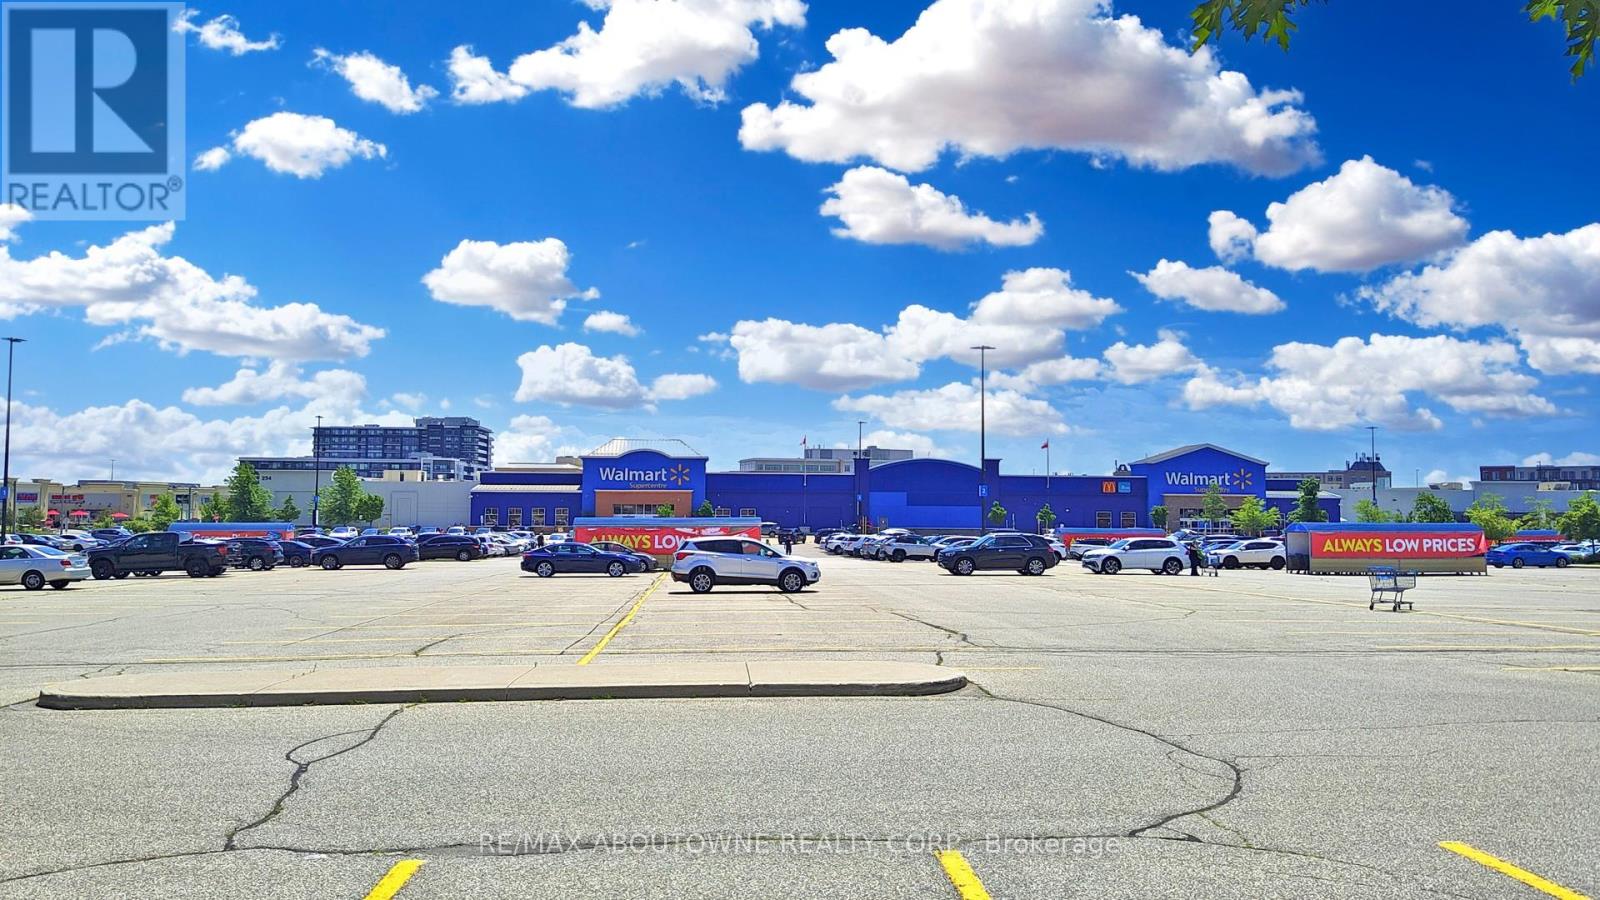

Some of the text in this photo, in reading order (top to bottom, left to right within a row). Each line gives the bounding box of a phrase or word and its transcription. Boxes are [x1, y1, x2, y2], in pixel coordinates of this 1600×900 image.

[600, 467, 667, 482] Walmart
[1166, 471, 1230, 486] Walmart
[1323, 538, 1476, 552] ALWAYS LOW PRICES
